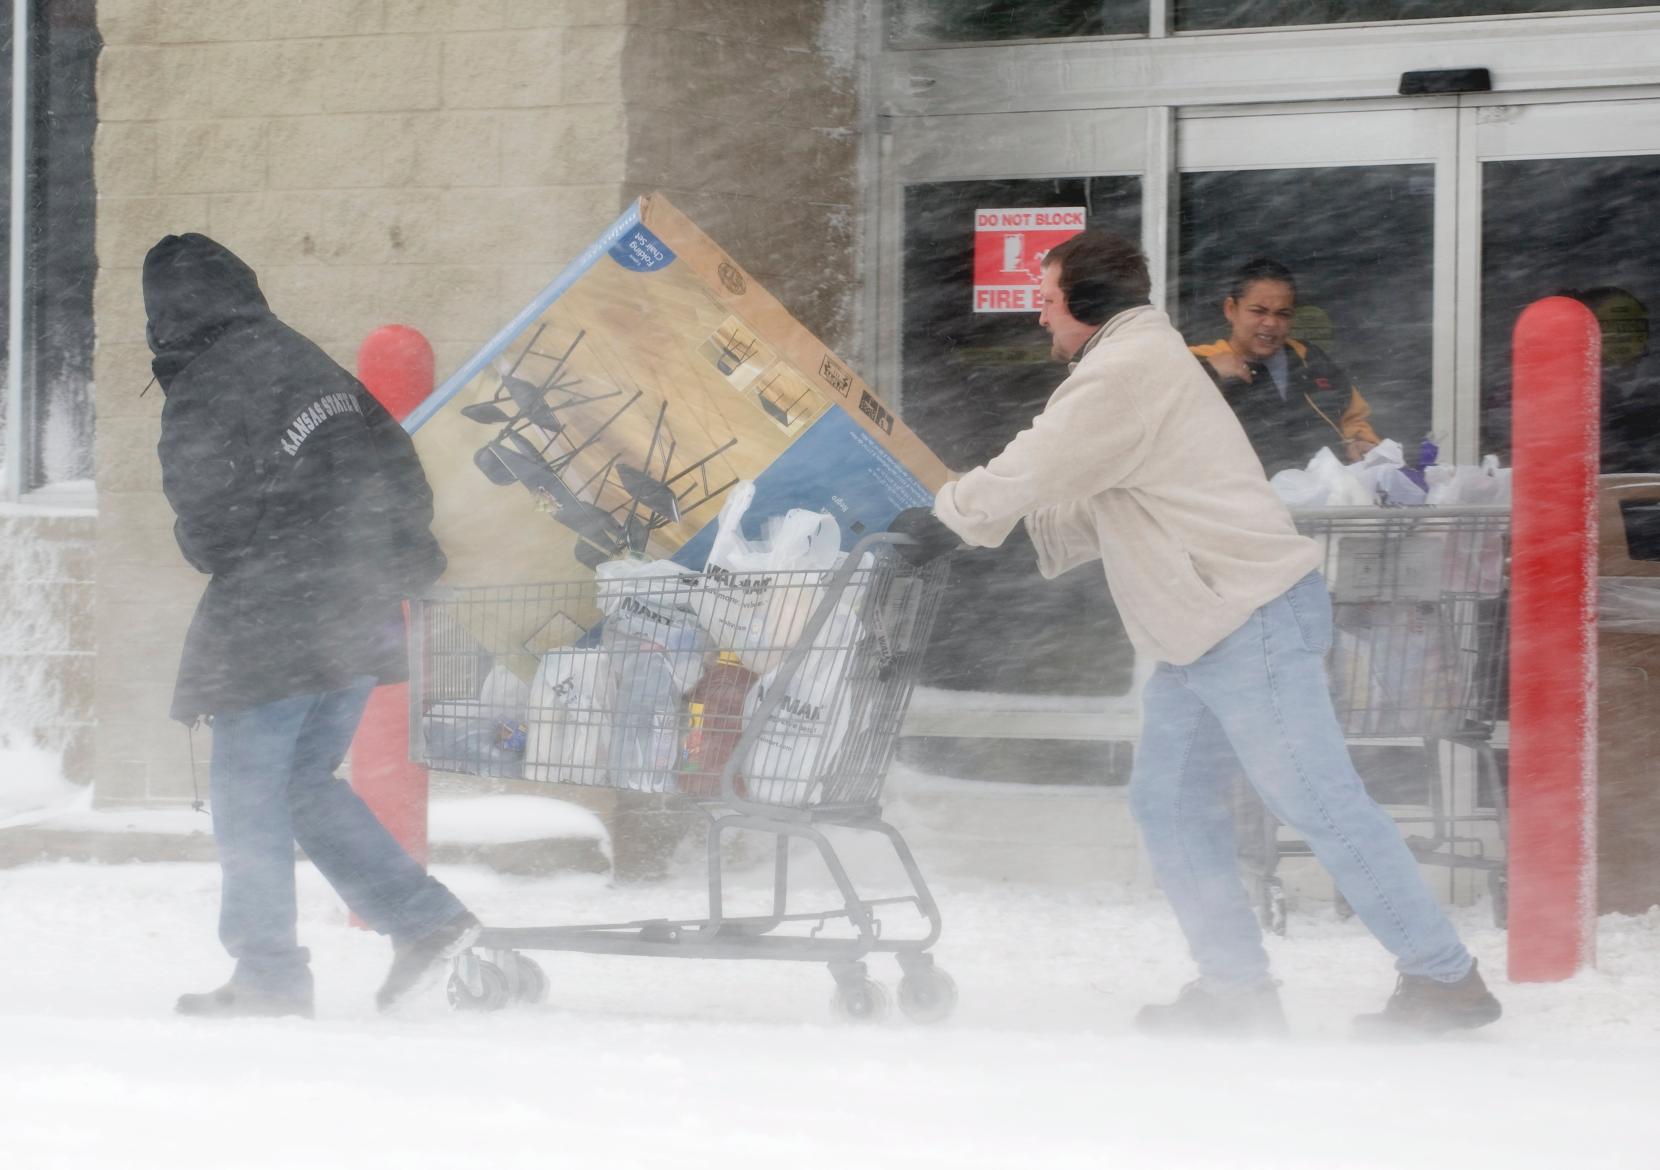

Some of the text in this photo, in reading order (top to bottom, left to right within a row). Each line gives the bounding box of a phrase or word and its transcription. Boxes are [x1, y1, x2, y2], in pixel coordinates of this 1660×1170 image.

[978, 212, 1083, 227] DO NOT BLOCK
[634, 232, 648, 246] Set
[629, 241, 655, 267] Folding
[645, 243, 664, 261] Chair
[976, 289, 1025, 309] FIRE
[281, 402, 327, 456] KANSAS
